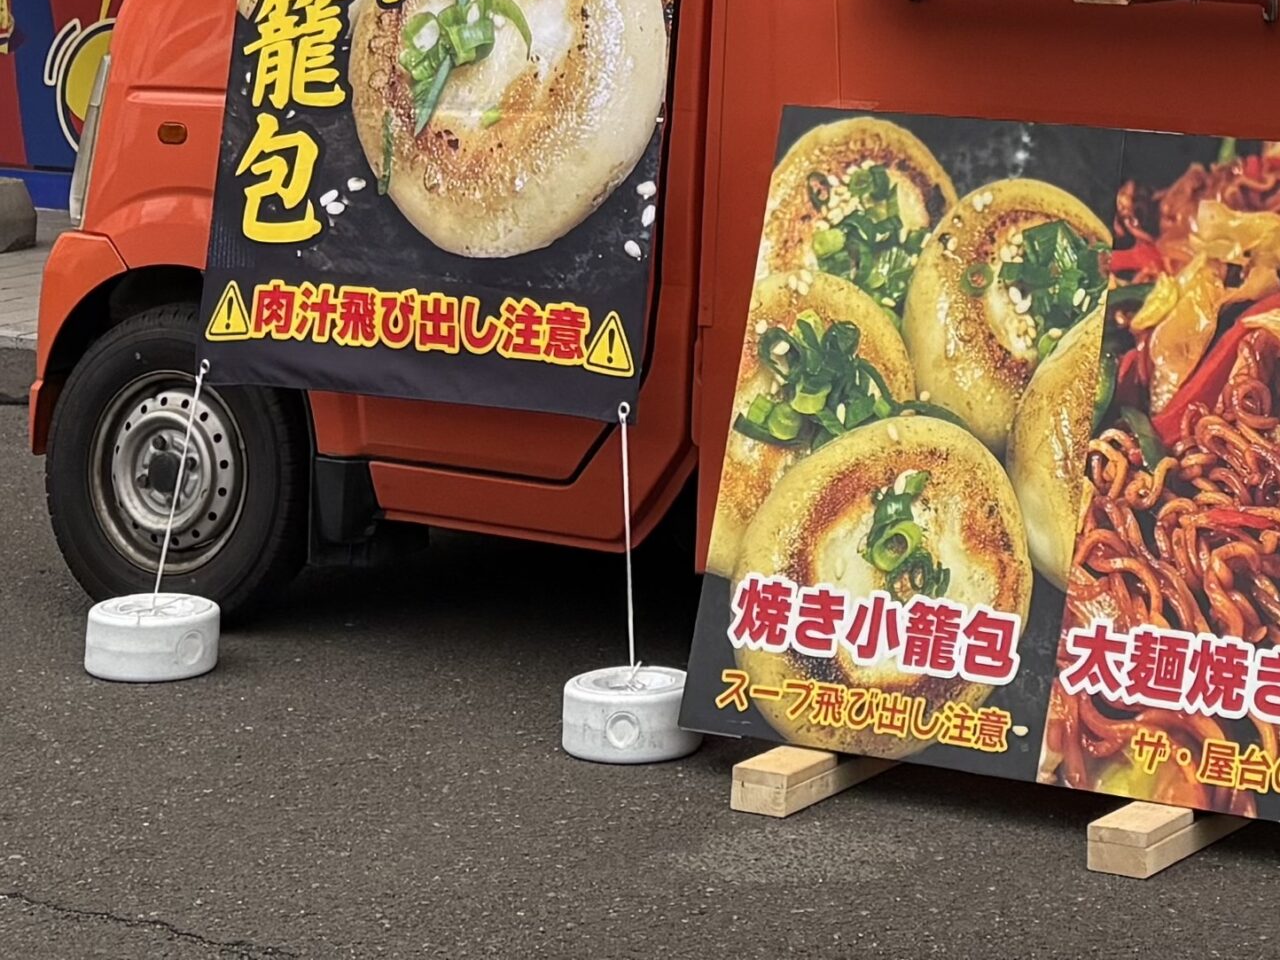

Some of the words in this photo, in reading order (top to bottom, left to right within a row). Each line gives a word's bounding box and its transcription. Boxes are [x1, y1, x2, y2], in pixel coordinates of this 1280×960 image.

[251, 279, 591, 363] 肉汁飛び出し注意
[727, 572, 1021, 685] 焼き小籠包
[715, 669, 1012, 753] スープ飛び出し注意
